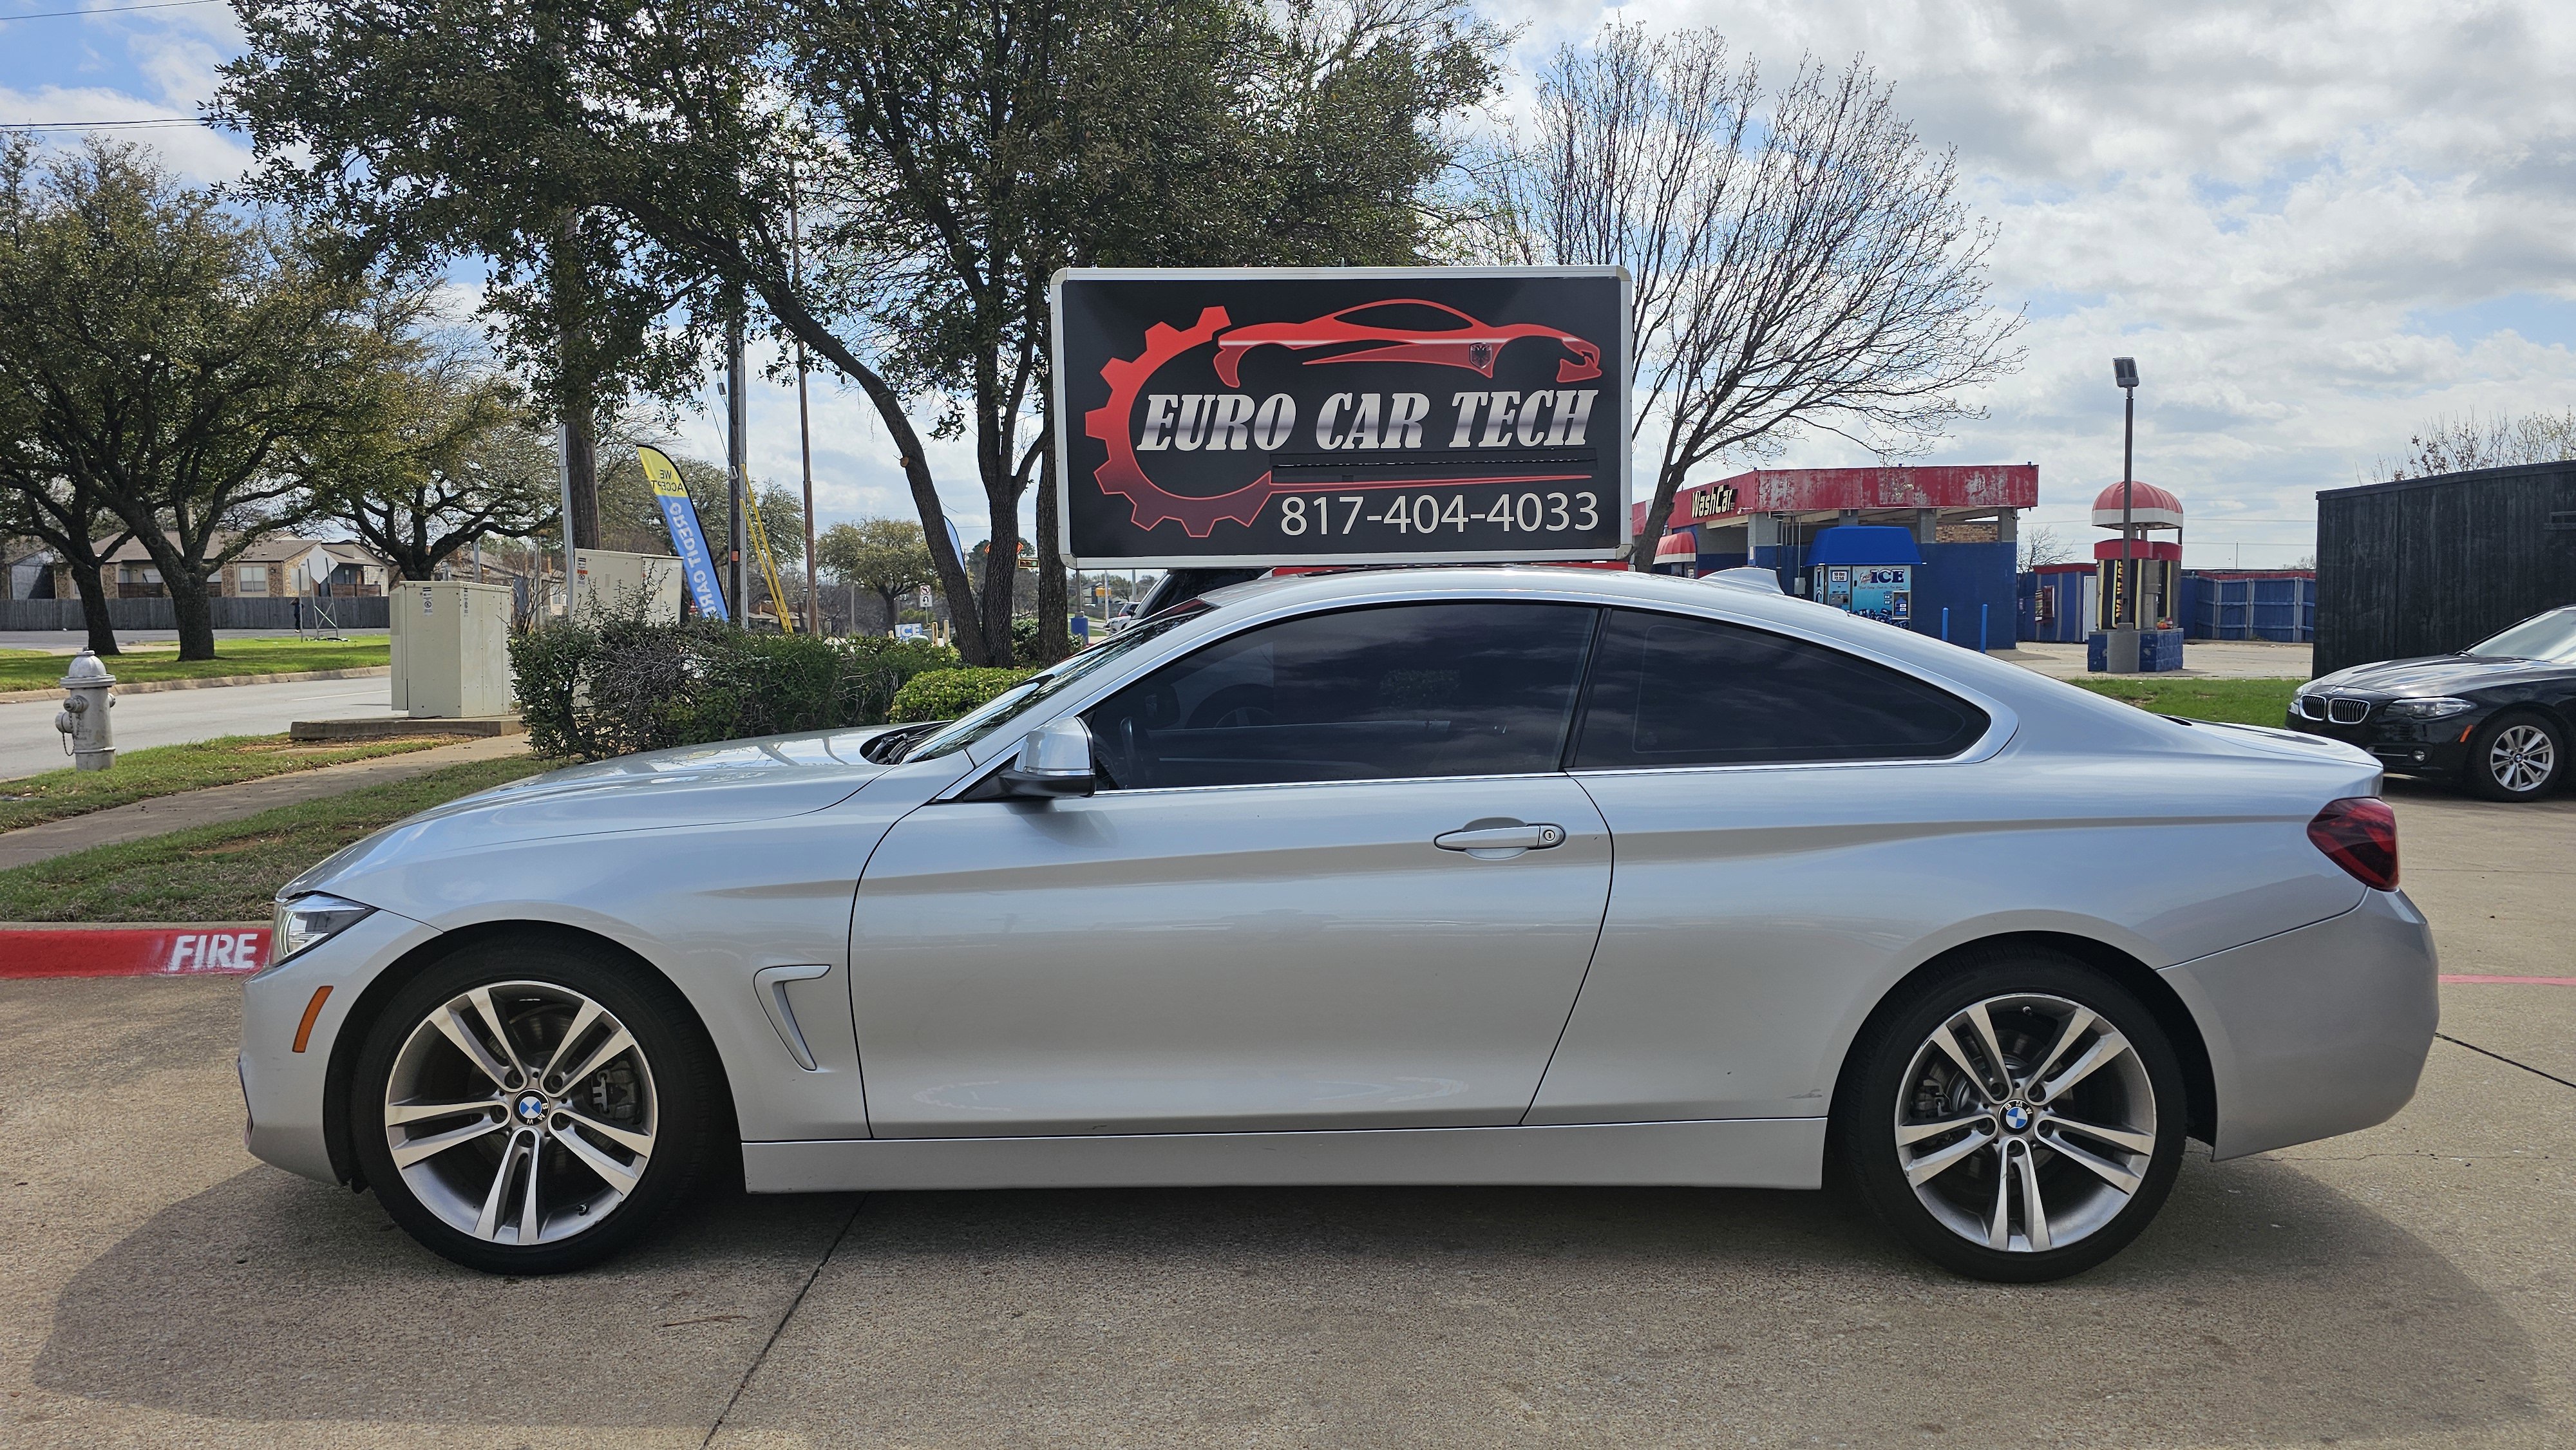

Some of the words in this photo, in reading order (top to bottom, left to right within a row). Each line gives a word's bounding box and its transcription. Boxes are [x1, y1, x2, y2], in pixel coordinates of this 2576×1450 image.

[1137, 393, 1296, 451] EURO
[1316, 391, 1430, 450] CAR
[1449, 389, 1598, 447] TECH
[1280, 492, 1599, 536] 817-404-4033
[1691, 485, 1733, 518] WashCar
[1870, 569, 1904, 583] ICE
[895, 623, 920, 637] ICE
[169, 934, 258, 971] FIRE
[526, 1102, 548, 1125] BMW
[2004, 1100, 2032, 1115] BMW
